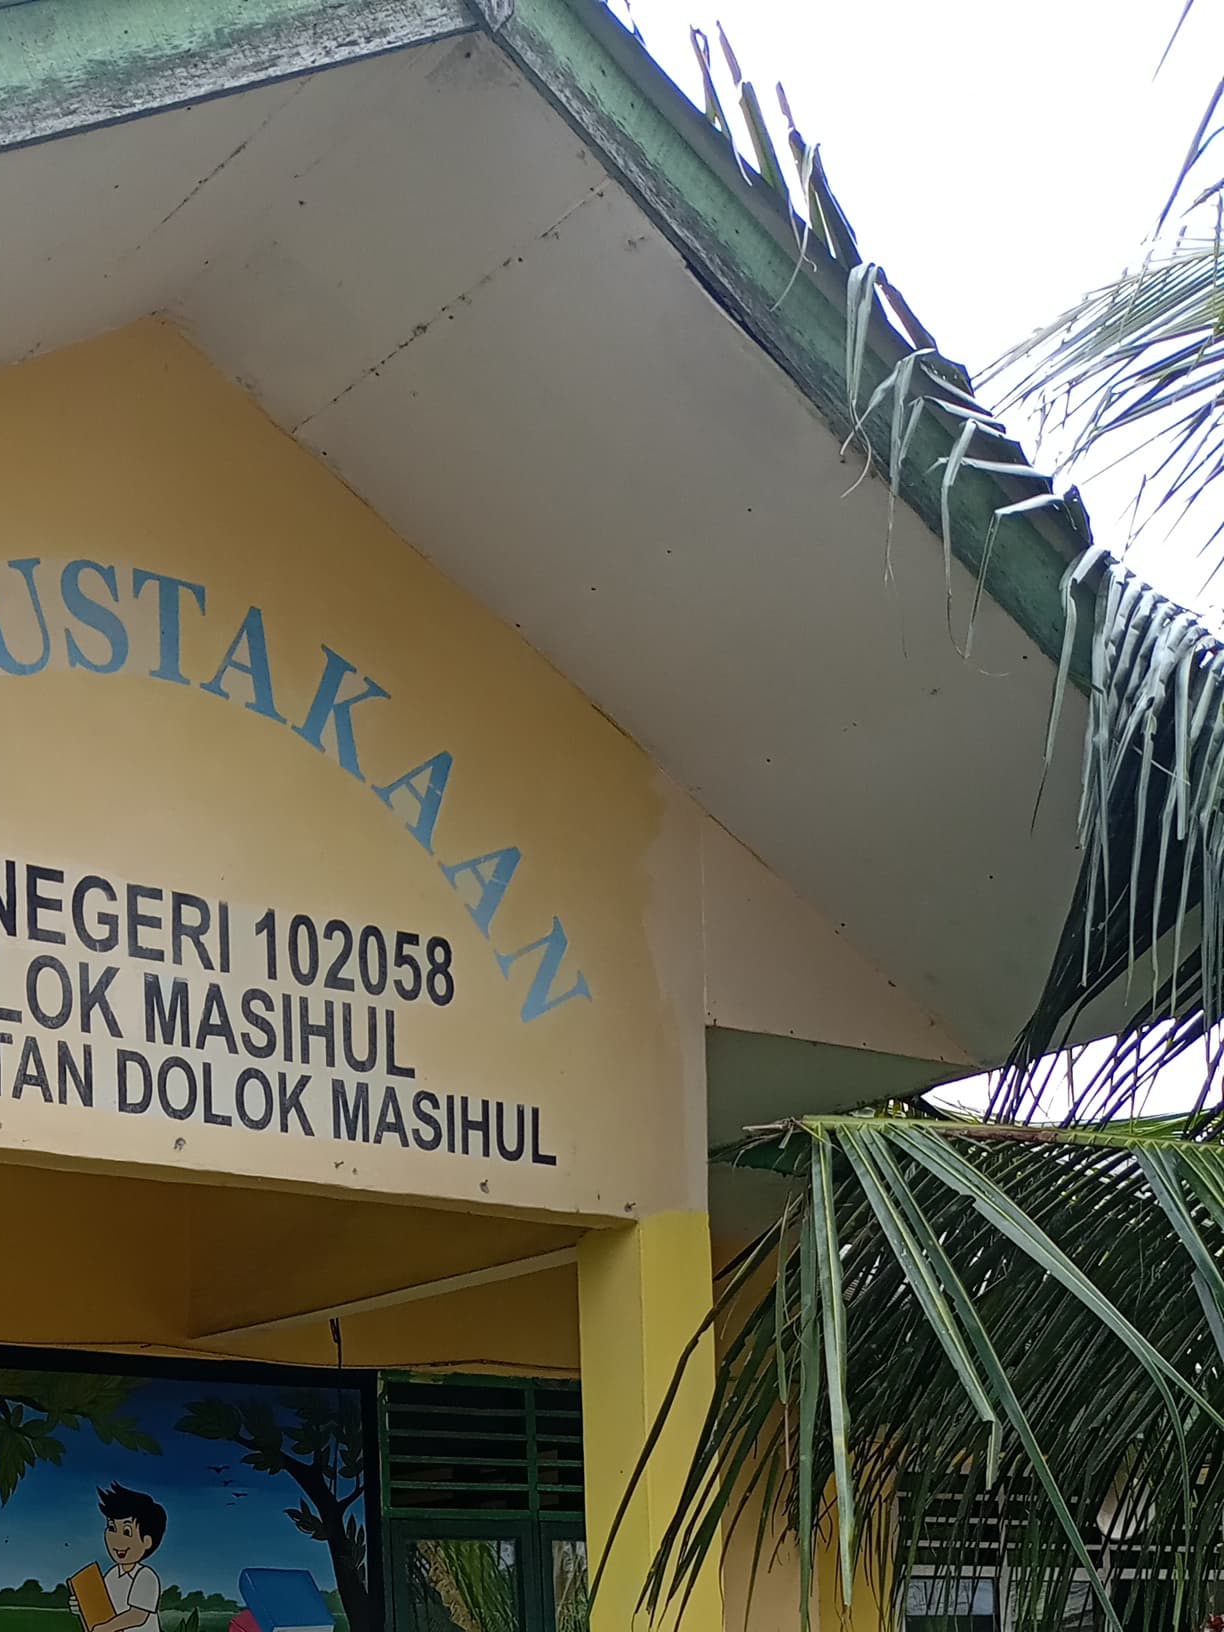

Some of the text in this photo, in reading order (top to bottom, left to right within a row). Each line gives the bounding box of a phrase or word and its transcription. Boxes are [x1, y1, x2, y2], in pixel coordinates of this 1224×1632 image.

[254, 907, 455, 1006] 102058
[143, 971, 416, 1079] MASIHUL
[116, 1048, 316, 1137] DOLOK
[331, 1077, 558, 1167] MASIHUL
